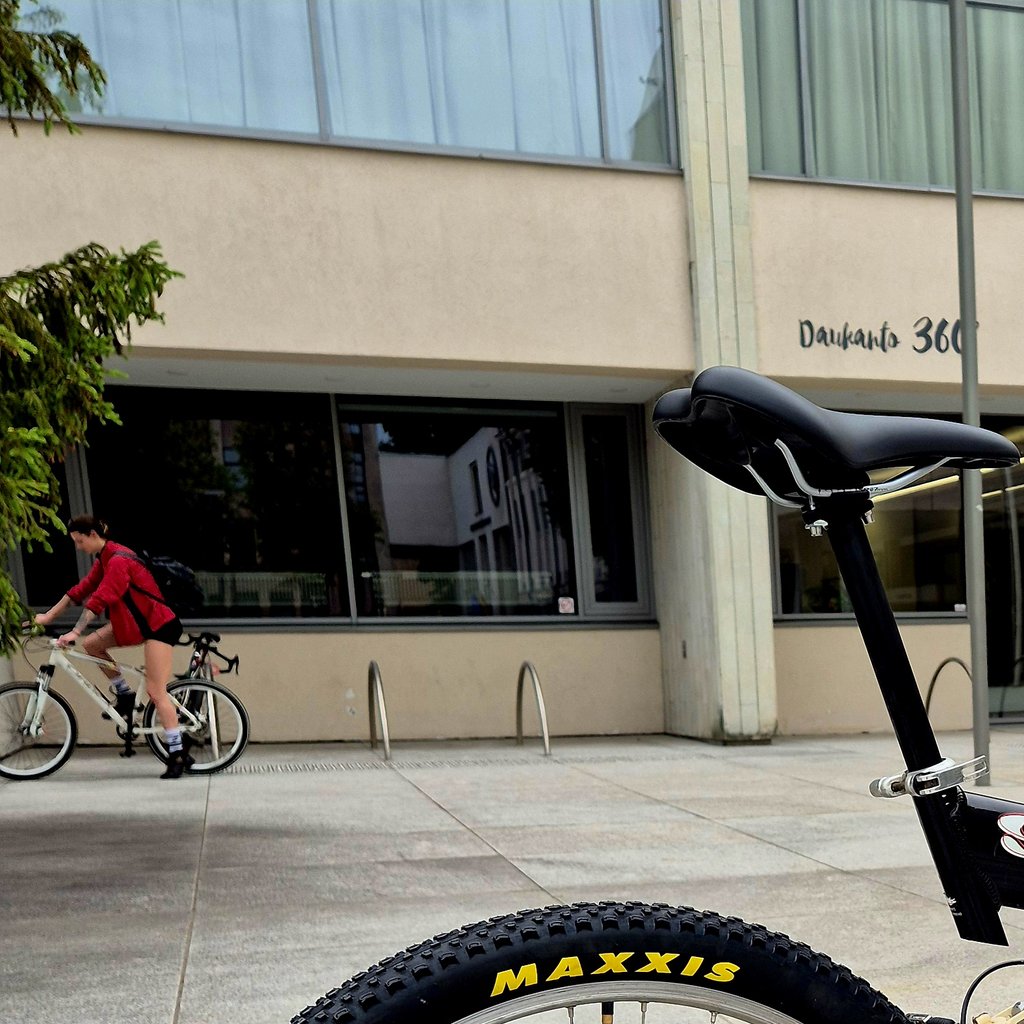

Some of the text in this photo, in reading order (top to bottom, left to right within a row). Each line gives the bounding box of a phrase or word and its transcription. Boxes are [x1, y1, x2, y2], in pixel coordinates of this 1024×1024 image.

[799, 316, 980, 353] Daukanto 360
[490, 952, 741, 998] MAXXIS
